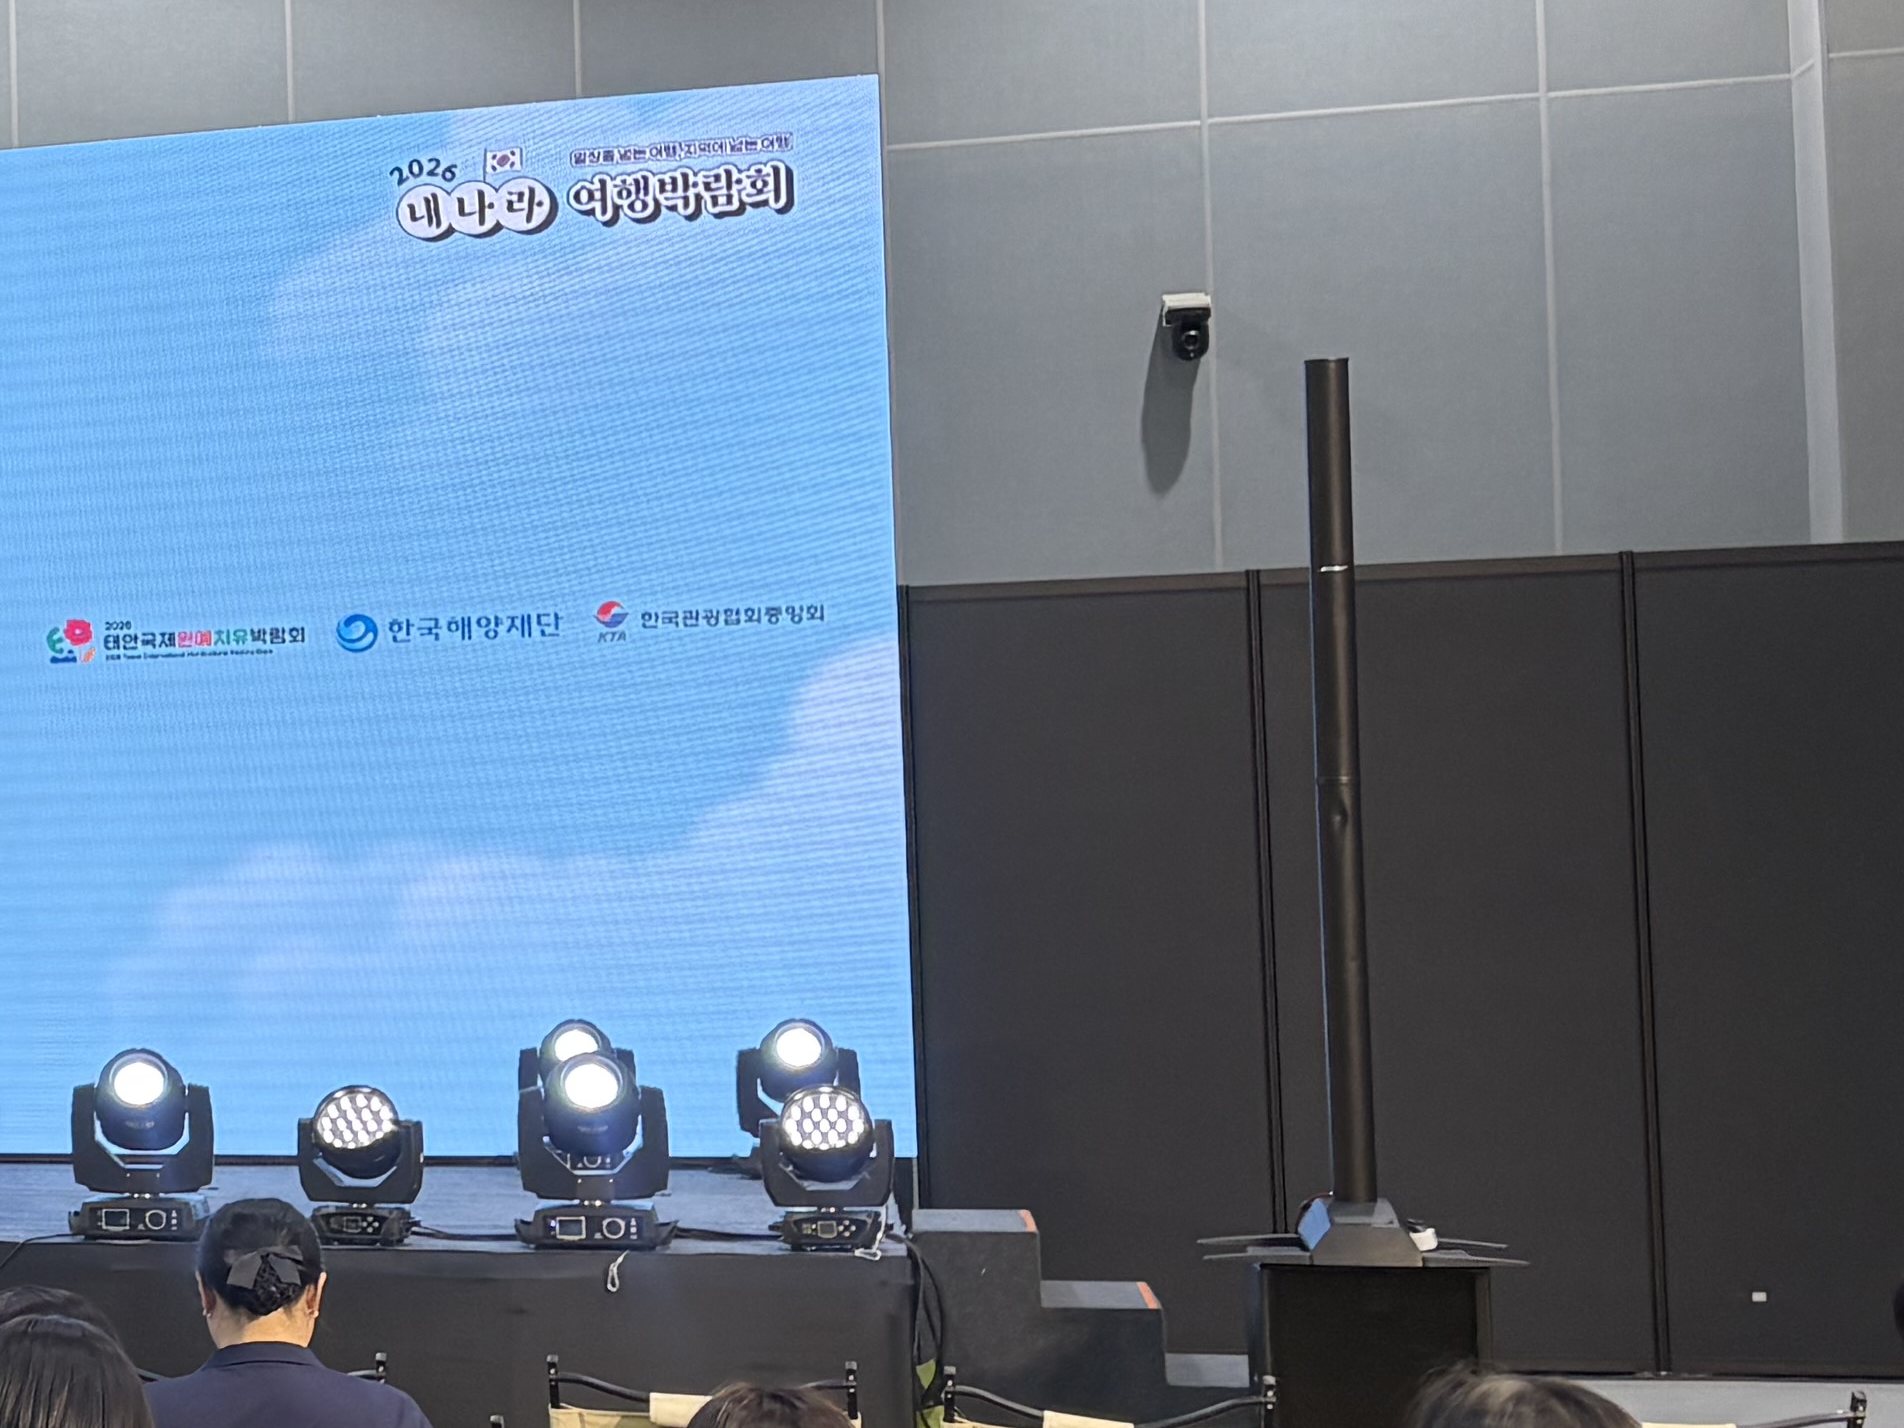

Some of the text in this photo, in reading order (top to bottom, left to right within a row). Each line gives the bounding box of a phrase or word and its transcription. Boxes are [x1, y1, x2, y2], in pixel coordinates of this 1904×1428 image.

[389, 157, 457, 186] 2026
[406, 163, 790, 229] 내나라 여행박람회
[388, 610, 563, 645] 한국해양재단
